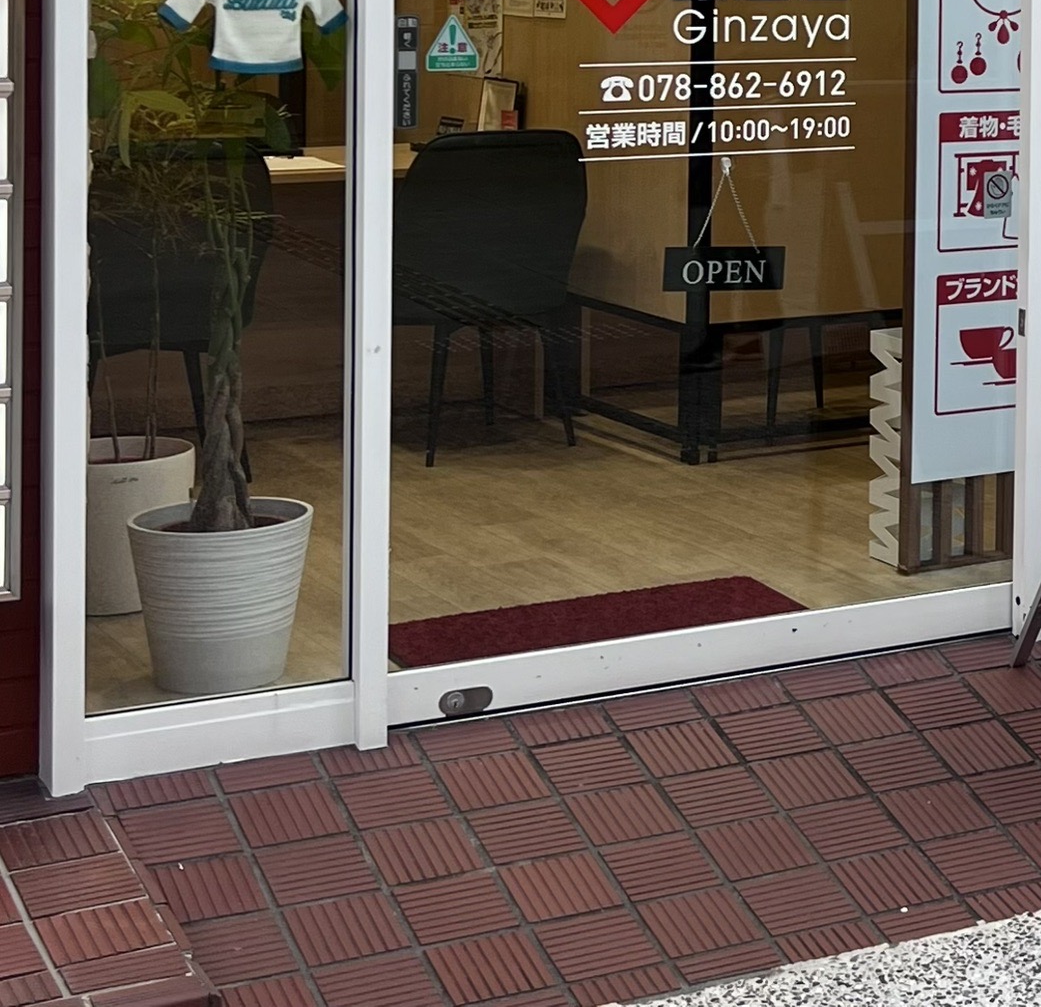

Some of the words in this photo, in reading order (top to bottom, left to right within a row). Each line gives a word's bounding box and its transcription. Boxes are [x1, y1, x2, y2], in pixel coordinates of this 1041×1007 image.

[673, 8, 850, 48] Ginzaya
[637, 70, 847, 103] 078-862-6912
[959, 115, 1021, 138] 着物・毛
[682, 260, 767, 285] OPEN
